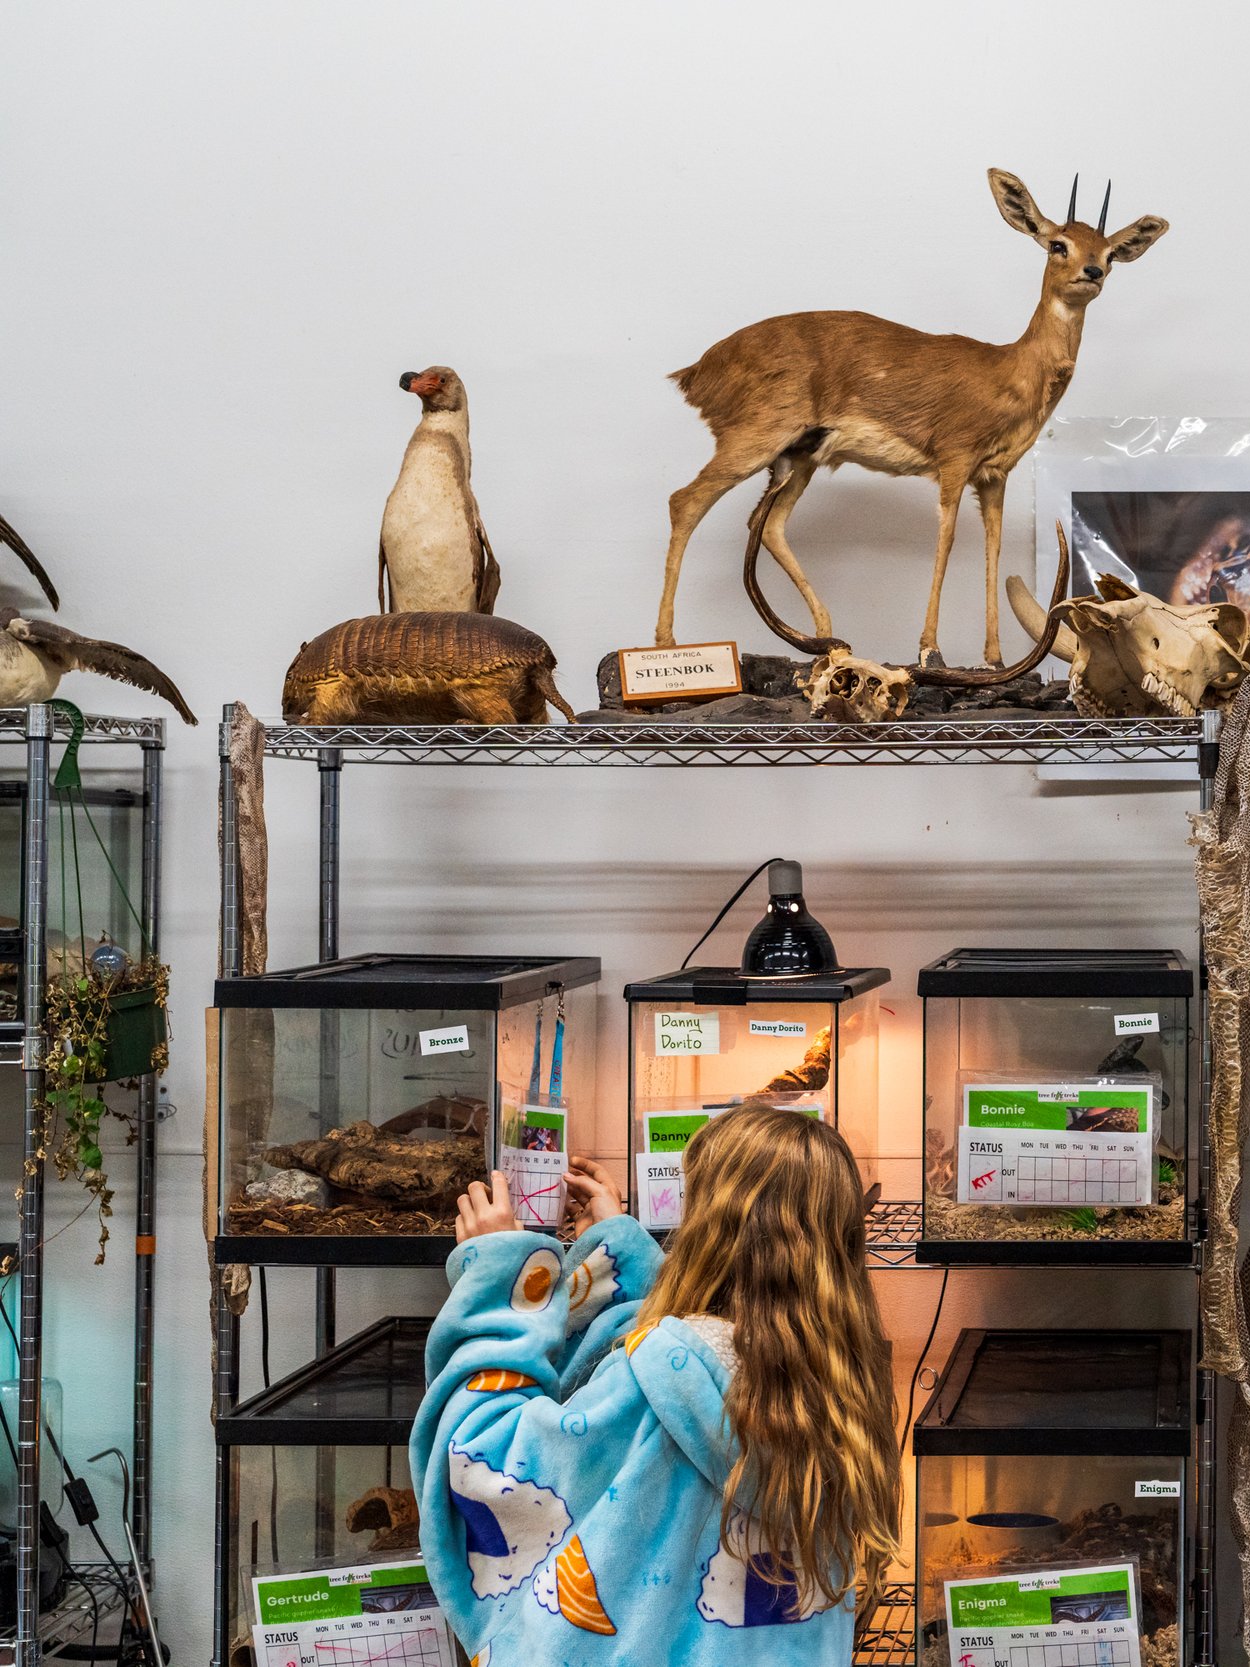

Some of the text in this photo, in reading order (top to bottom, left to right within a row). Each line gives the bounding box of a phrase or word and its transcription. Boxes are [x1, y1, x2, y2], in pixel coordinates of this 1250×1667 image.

[672, 651, 702, 659] AFRICA
[636, 663, 715, 679] STEENBOK
[665, 681, 685, 689] 1994
[661, 1014, 703, 1034] Danny
[751, 1023, 804, 1033] Danny Dorito
[1118, 1017, 1153, 1028] Bonnie
[429, 1036, 464, 1047] Bronze
[661, 1034, 702, 1049] Dorito
[981, 1104, 1026, 1115] Bonnie
[651, 1132, 691, 1143] Danny
[969, 1142, 1003, 1153] STATUS
[648, 1167, 680, 1177] STATUS
[1001, 1169, 1015, 1177] OUT
[1140, 1484, 1177, 1494] Enigma
[267, 1591, 330, 1606] Gertrude
[958, 1598, 1007, 1610] Enigma
[264, 1632, 298, 1644] STATUS
[960, 1636, 994, 1647] STATUS
[301, 1656, 315, 1664] OUT
